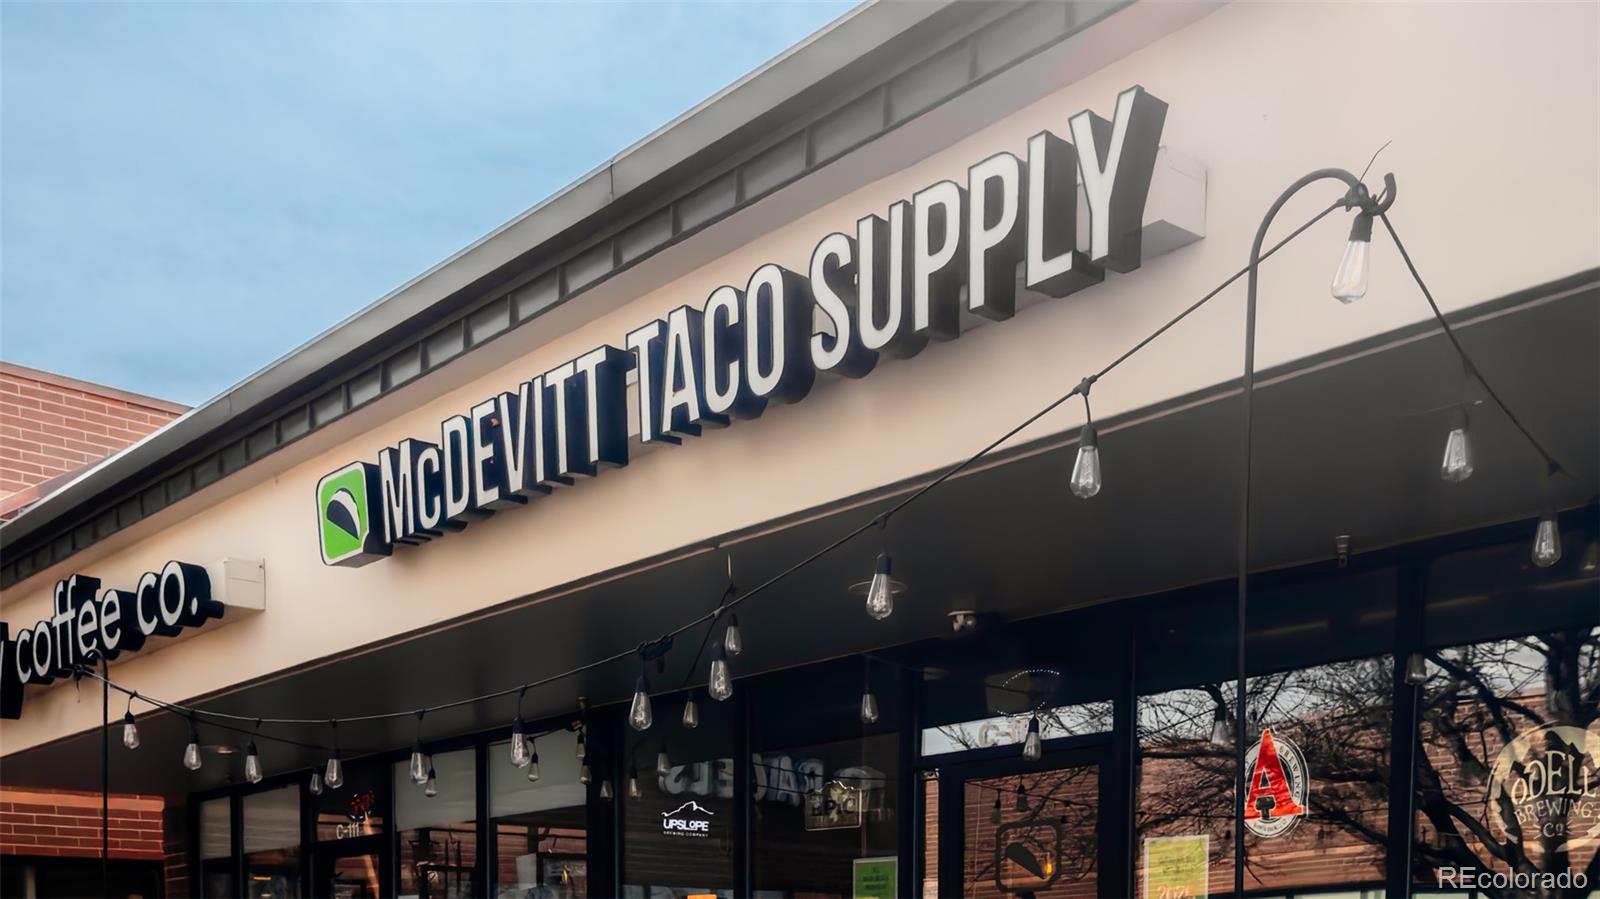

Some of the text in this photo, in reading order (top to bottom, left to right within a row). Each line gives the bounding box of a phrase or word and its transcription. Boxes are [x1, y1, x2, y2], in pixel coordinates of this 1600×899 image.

[379, 85, 1137, 544] McDEVITT TACO SUPPLY
[16, 574, 121, 684] coffee
[137, 561, 198, 635] co.
[1511, 750, 1597, 805] ODELL
[336, 822, 360, 840] C-111
[663, 818, 710, 832] UPSLOPE
[1513, 797, 1594, 825] BREWING
